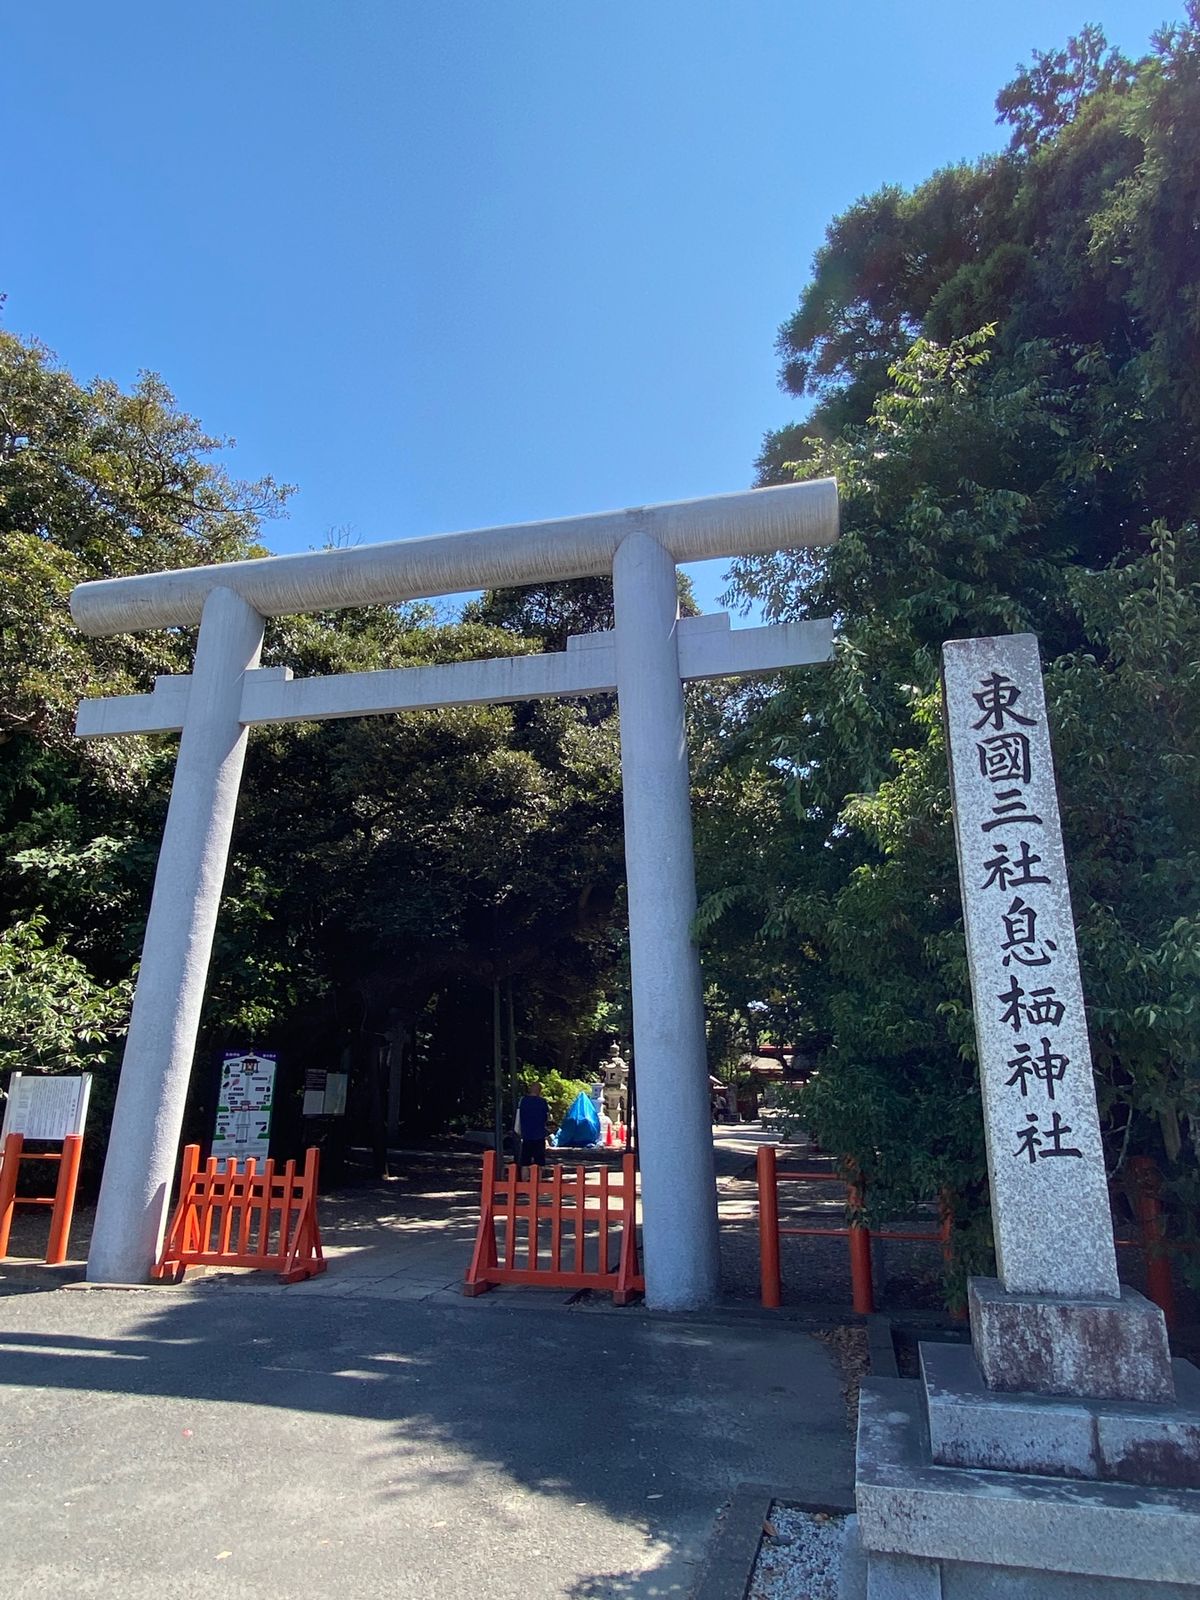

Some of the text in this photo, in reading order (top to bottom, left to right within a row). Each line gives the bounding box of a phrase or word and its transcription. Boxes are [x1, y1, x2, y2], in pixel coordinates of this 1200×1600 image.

[972, 672, 1082, 1164] 東國三社息栖神社
